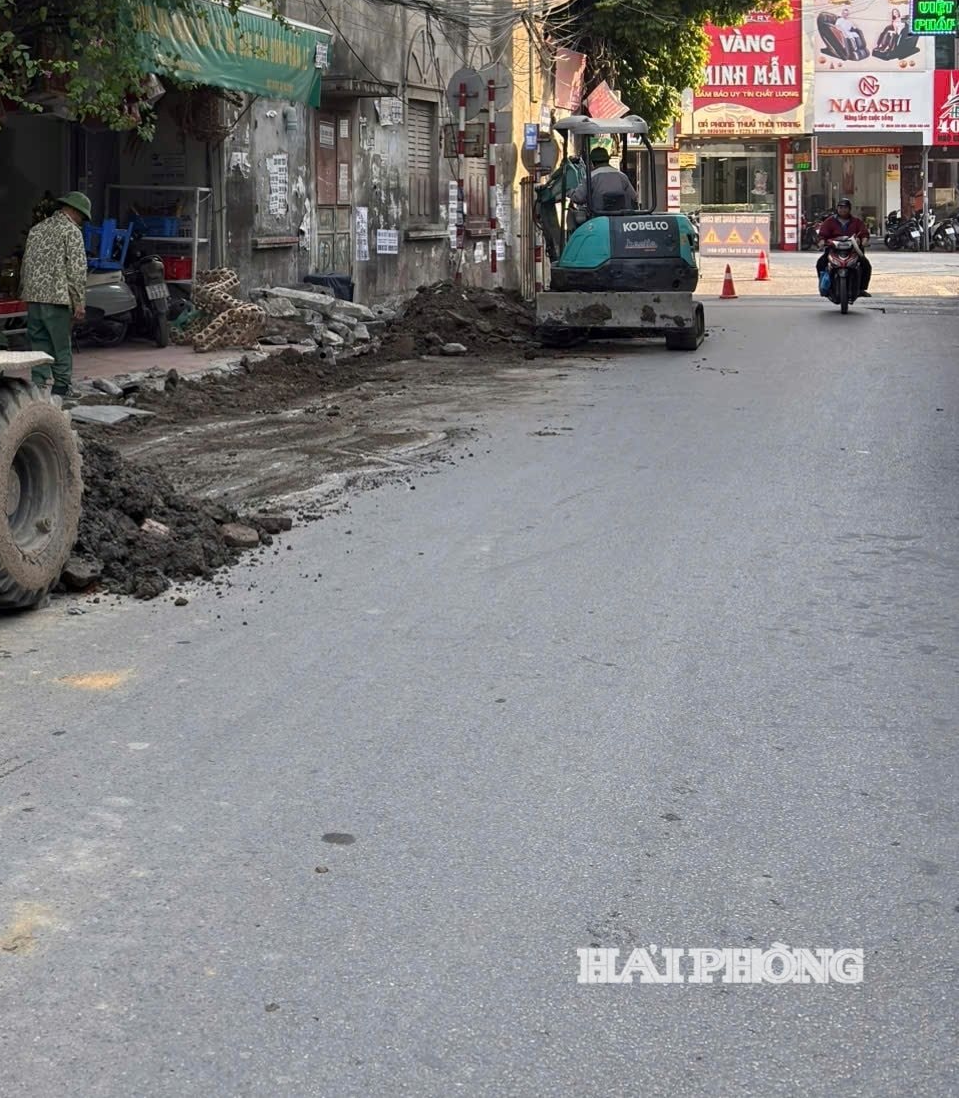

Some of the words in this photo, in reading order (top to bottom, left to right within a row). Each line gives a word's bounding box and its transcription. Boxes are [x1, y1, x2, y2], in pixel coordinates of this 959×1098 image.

[719, 29, 775, 53] VÀNG
[829, 99, 911, 113] NAGASHI
[622, 221, 669, 232] KOBELCO
